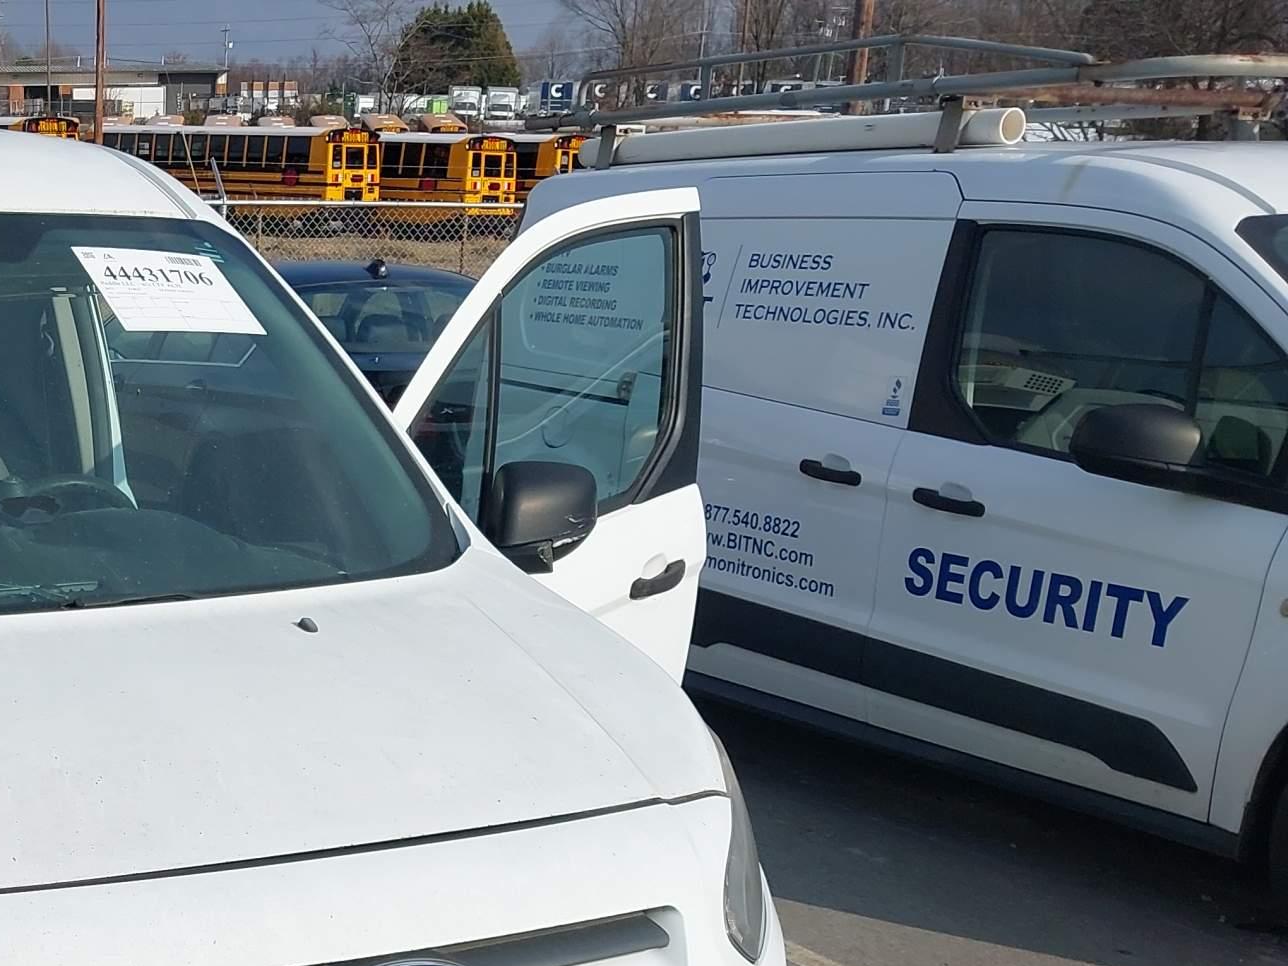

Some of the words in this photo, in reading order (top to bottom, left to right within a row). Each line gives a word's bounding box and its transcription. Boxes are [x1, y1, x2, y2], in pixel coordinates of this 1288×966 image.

[551, 83, 564, 98] C
[545, 262, 583, 275] BURGLAR
[583, 264, 620, 277] ALARMS
[748, 252, 833, 271] BUSINESS
[103, 265, 214, 287] 44431706
[541, 279, 574, 291] REMOTE
[575, 280, 611, 293] VIEWING
[740, 278, 870, 300] IMPROVEMENT
[537, 295, 568, 308] DIGITAL
[568, 297, 617, 311] RECORDING
[534, 311, 562, 324] WHOLE
[562, 313, 587, 326] HOME
[588, 315, 644, 331] AUTOMATION
[876, 311, 916, 331] INC.
[705, 503, 801, 539] 877.540.8822
[704, 555, 835, 598] monitronics.com
[903, 547, 1191, 648] SECURITY
